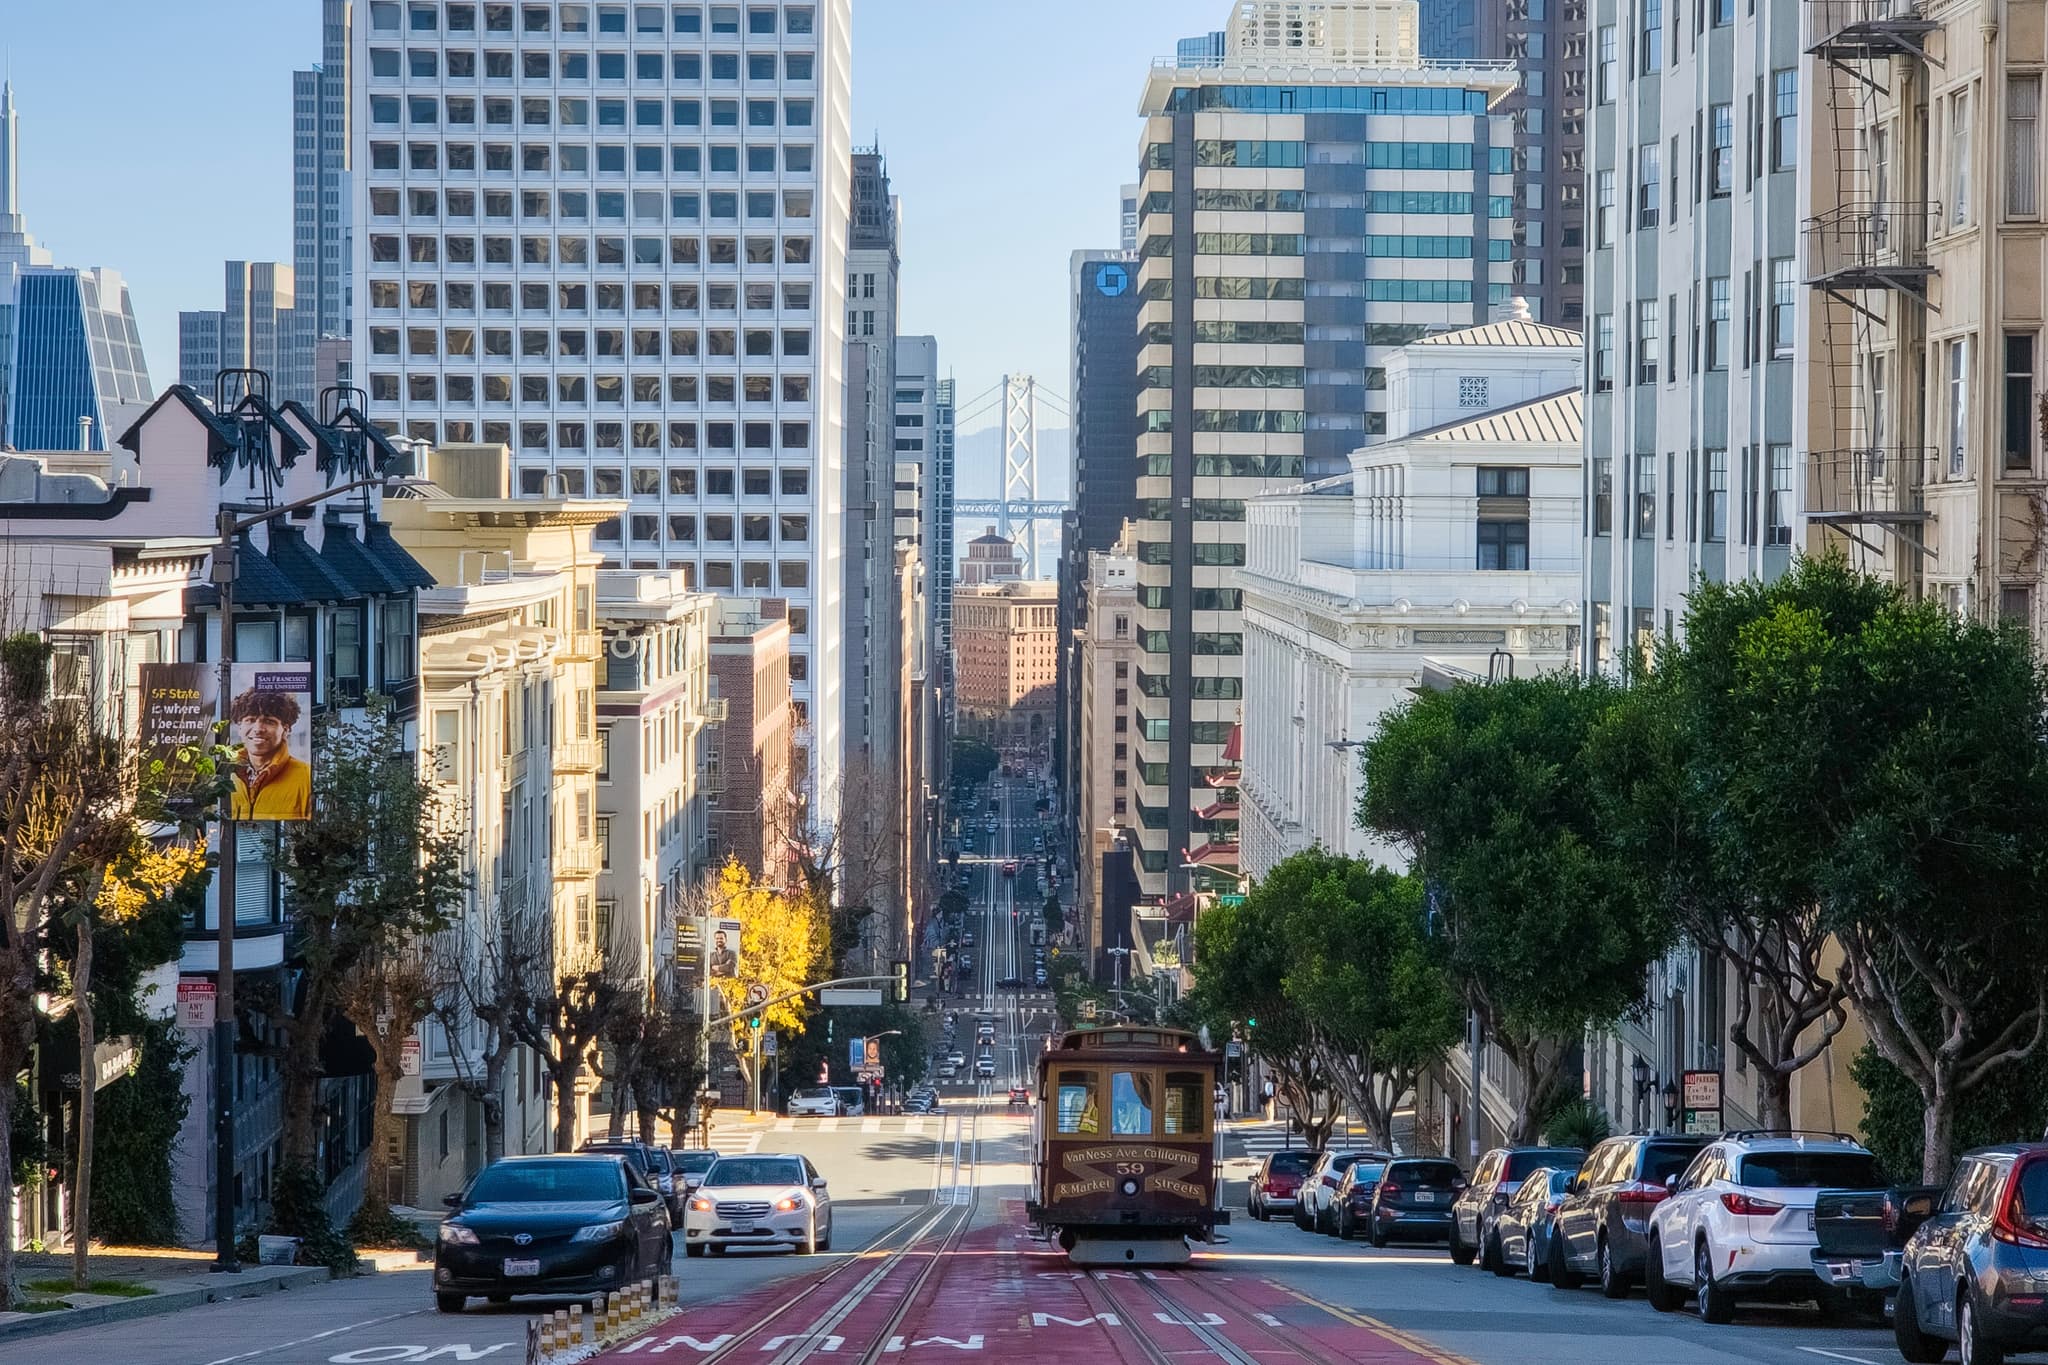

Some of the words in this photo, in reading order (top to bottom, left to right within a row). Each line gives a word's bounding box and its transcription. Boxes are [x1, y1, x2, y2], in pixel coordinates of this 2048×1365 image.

[151, 688, 167, 699] SF
[169, 688, 200, 699] State
[164, 703, 200, 714] where
[158, 718, 204, 729] became
[187, 1011, 204, 1019] TIME
[1684, 1074, 1695, 1083] NO
[1687, 1113, 1694, 1122] 2
[1066, 1153, 1085, 1162] Van
[1086, 1150, 1113, 1160] Ness
[1144, 1148, 1198, 1165] California
[1116, 1162, 1145, 1175] 59
[1060, 1184, 1068, 1193] &
[1071, 1179, 1110, 1193] Market
[1154, 1178, 1200, 1195] Streets
